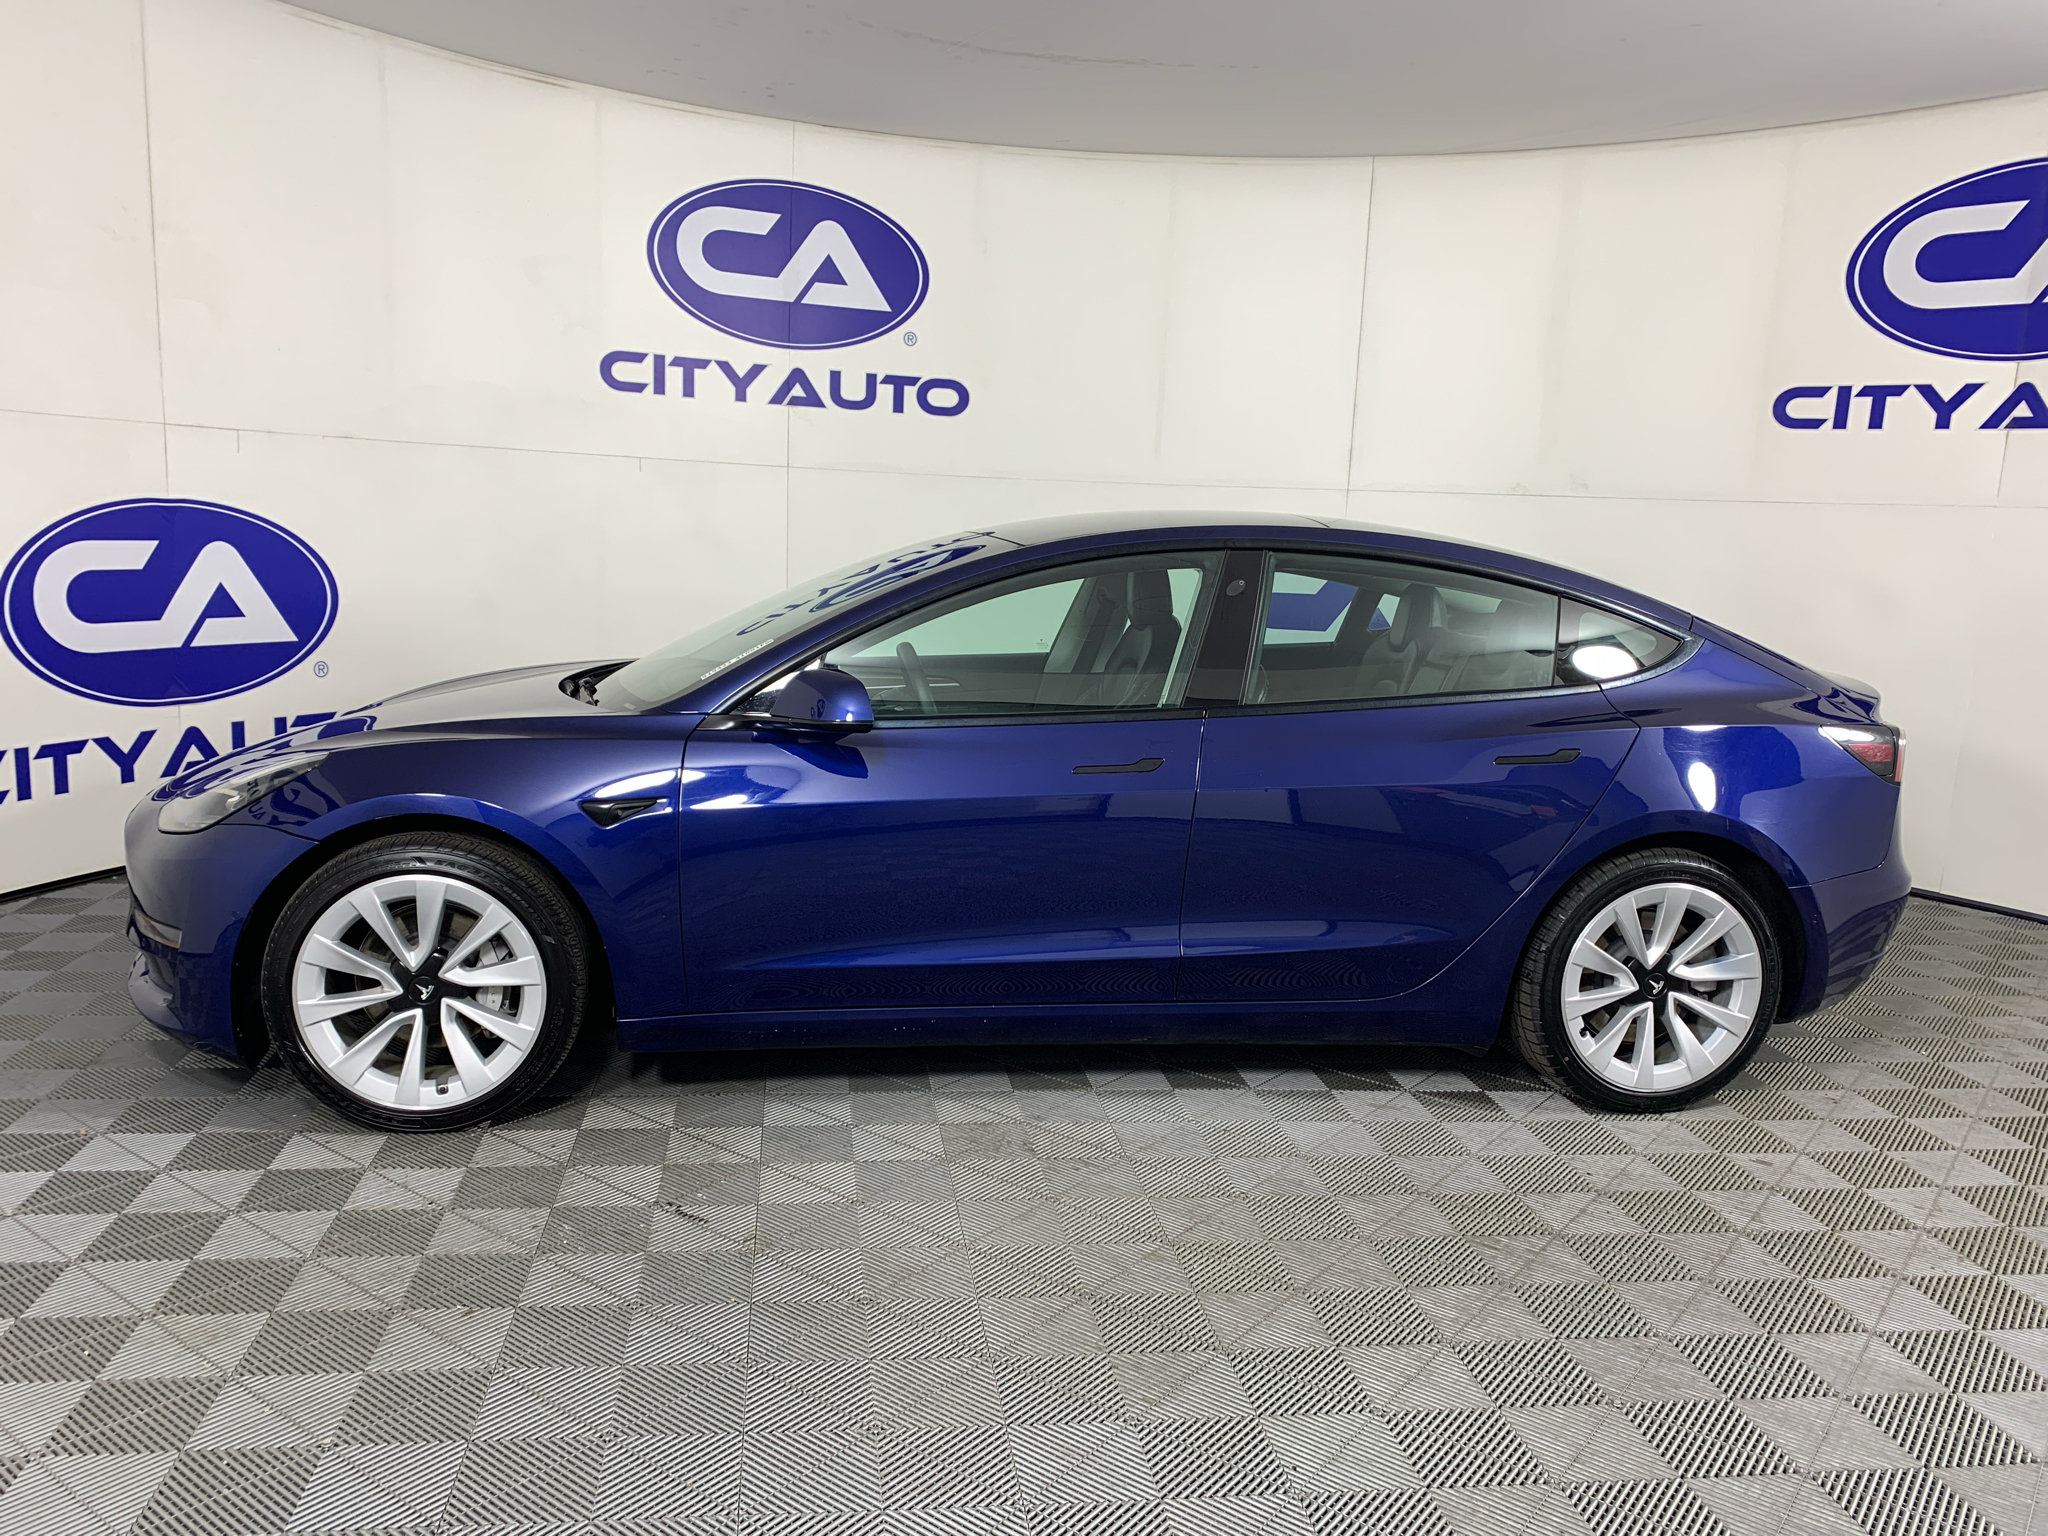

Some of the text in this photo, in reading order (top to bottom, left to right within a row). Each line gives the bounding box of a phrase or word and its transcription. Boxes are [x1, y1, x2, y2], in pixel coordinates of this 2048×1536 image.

[676, 206, 892, 312] CA
[600, 350, 970, 417] CITY AUTO
[1772, 383, 1987, 430] CITY
[33, 540, 299, 653] CA
[0, 730, 157, 805] ITY
